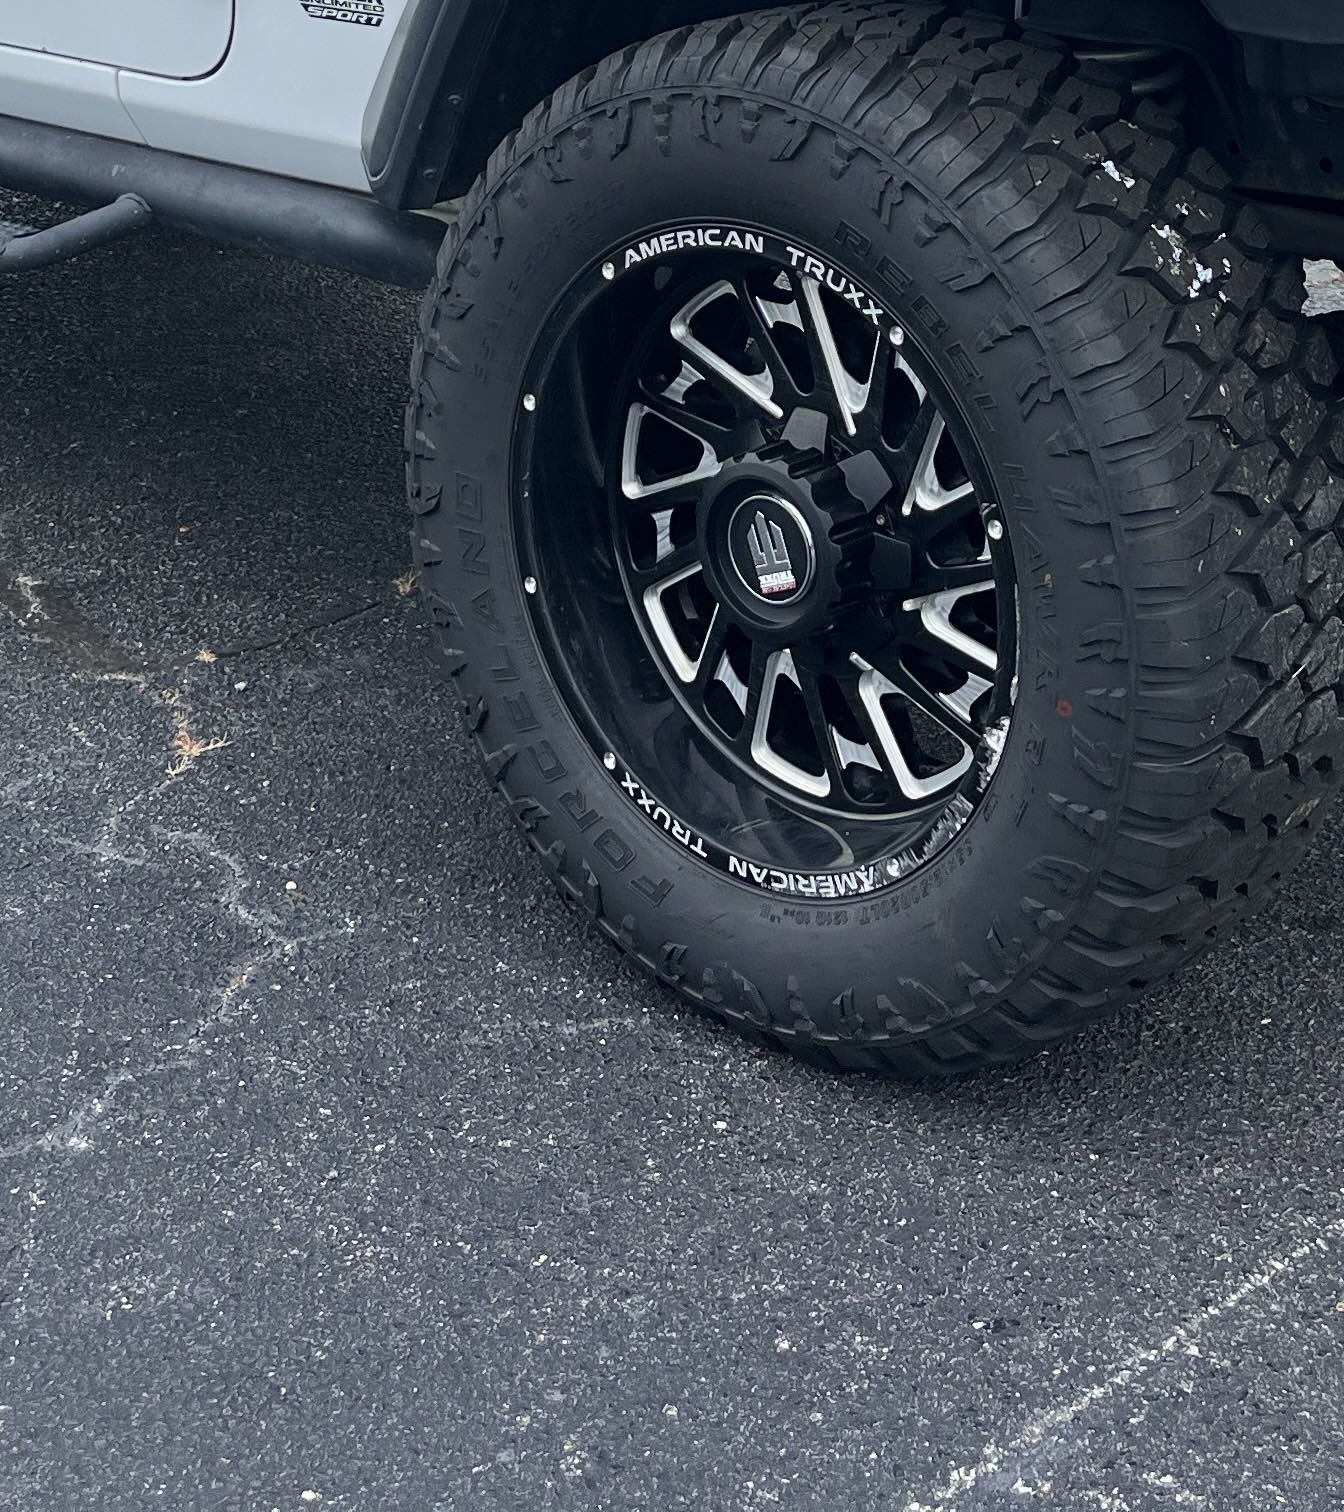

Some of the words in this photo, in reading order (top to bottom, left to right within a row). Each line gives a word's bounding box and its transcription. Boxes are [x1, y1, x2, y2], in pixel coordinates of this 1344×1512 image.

[306, 5, 383, 26] SPORT
[624, 228, 763, 269] AMERICAN
[786, 246, 883, 326] TRUXX
[833, 220, 998, 433] REBEL
[456, 471, 675, 908] FORCELAND
[621, 771, 707, 858] TRUXX
[728, 855, 875, 897] AMERICAN
